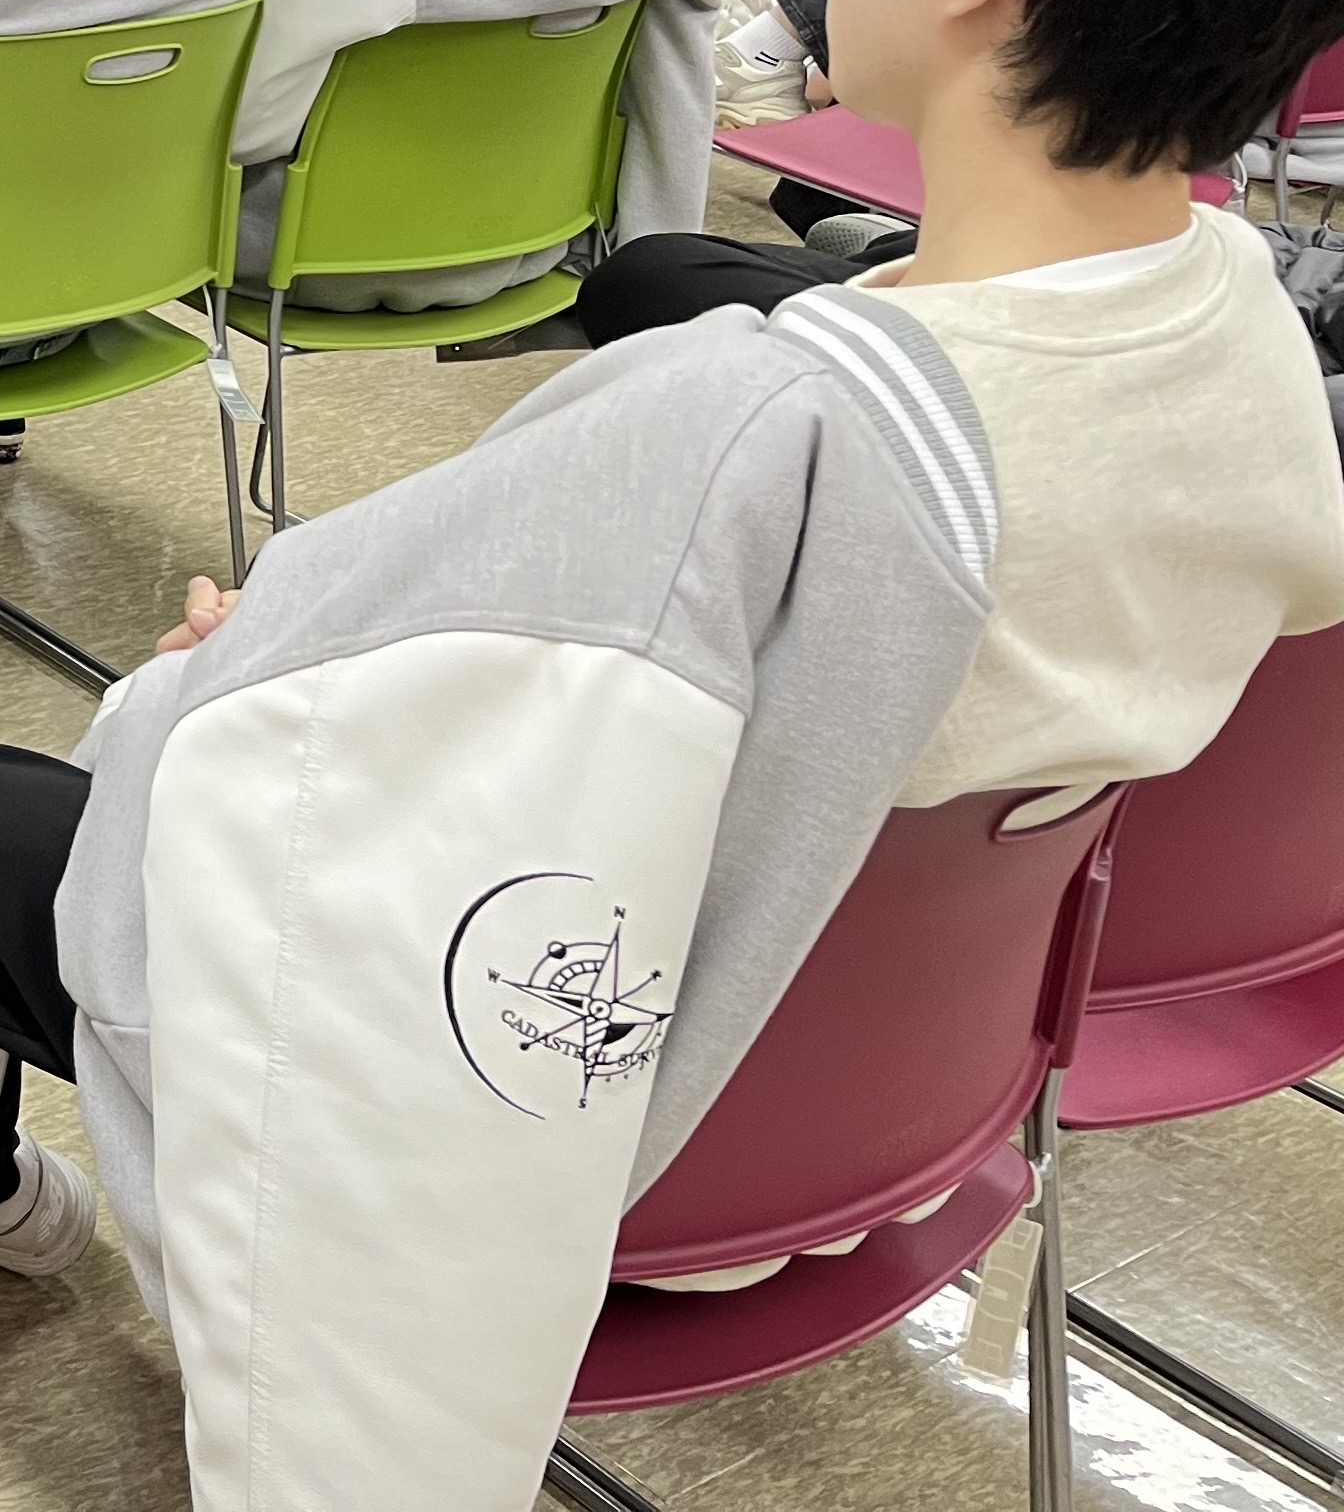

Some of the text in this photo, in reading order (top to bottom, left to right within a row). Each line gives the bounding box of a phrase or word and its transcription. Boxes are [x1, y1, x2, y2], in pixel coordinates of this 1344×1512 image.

[614, 906, 626, 920] N
[487, 967, 501, 984] W
[577, 1098, 587, 1110] S
